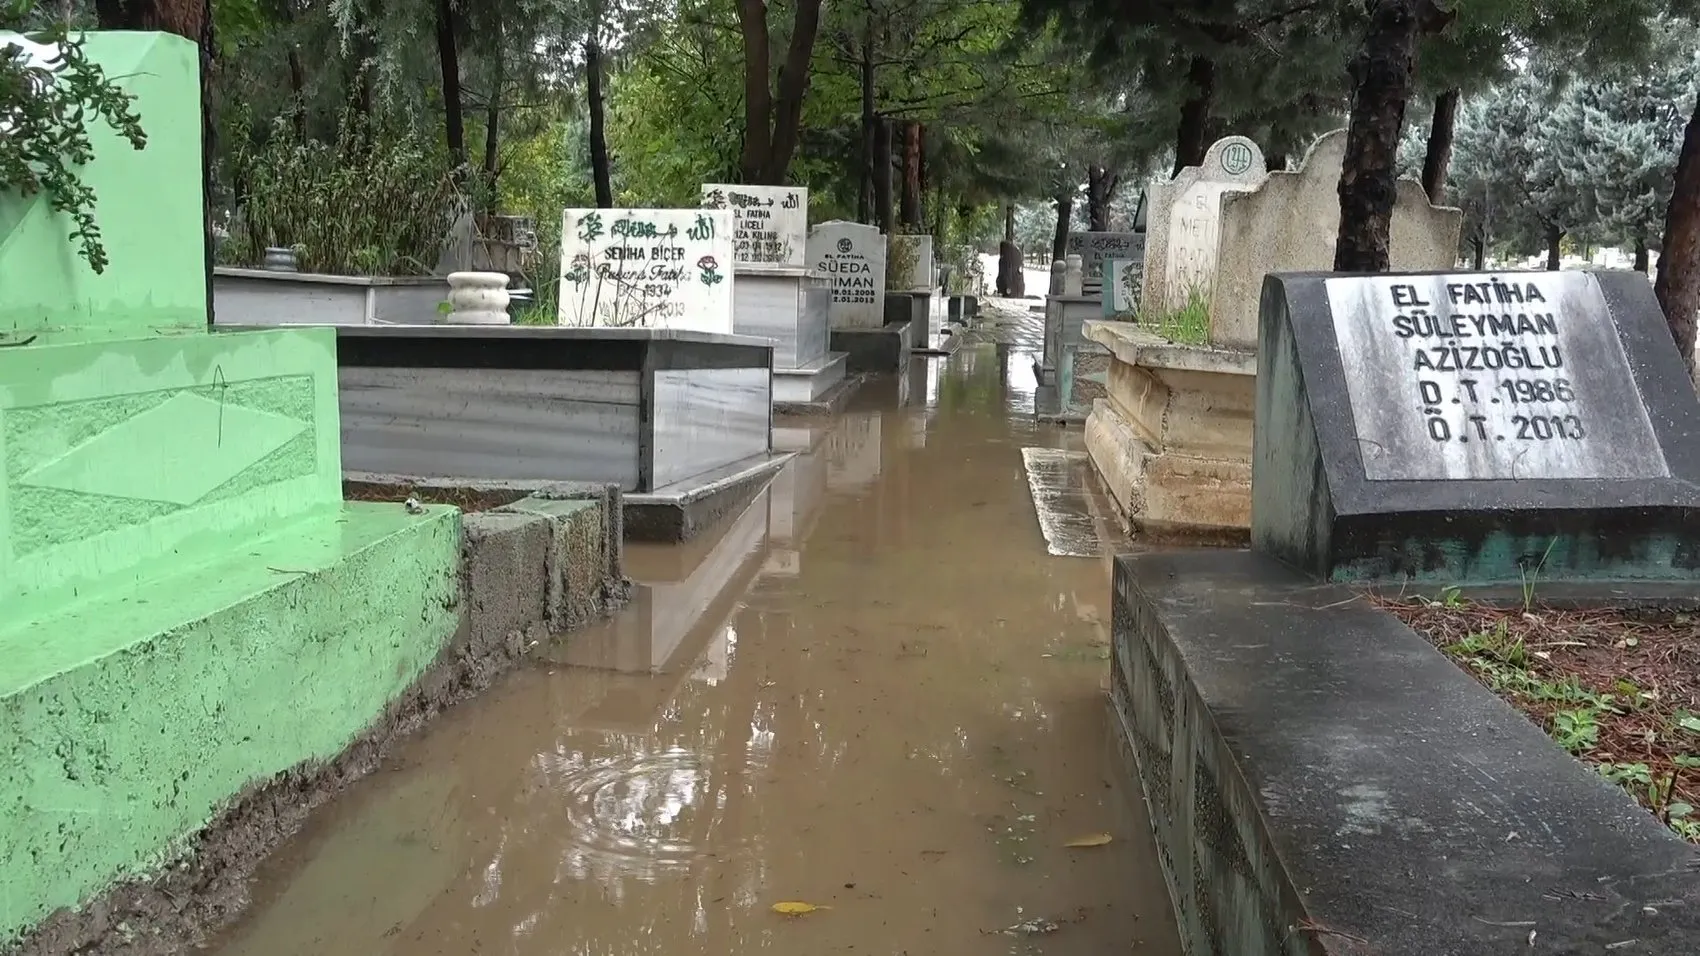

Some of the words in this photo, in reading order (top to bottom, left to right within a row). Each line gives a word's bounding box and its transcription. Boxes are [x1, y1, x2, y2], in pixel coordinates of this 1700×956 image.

[604, 245, 645, 260] SENİHA
[651, 246, 685, 261] BİÇER
[818, 260, 870, 274] SÜEDA
[1390, 284, 1430, 306] EL
[1447, 276, 1547, 304] FATİHA
[1392, 310, 1559, 339] SÜLEYMAN
[1413, 340, 1563, 372] AZİZOĞLU
